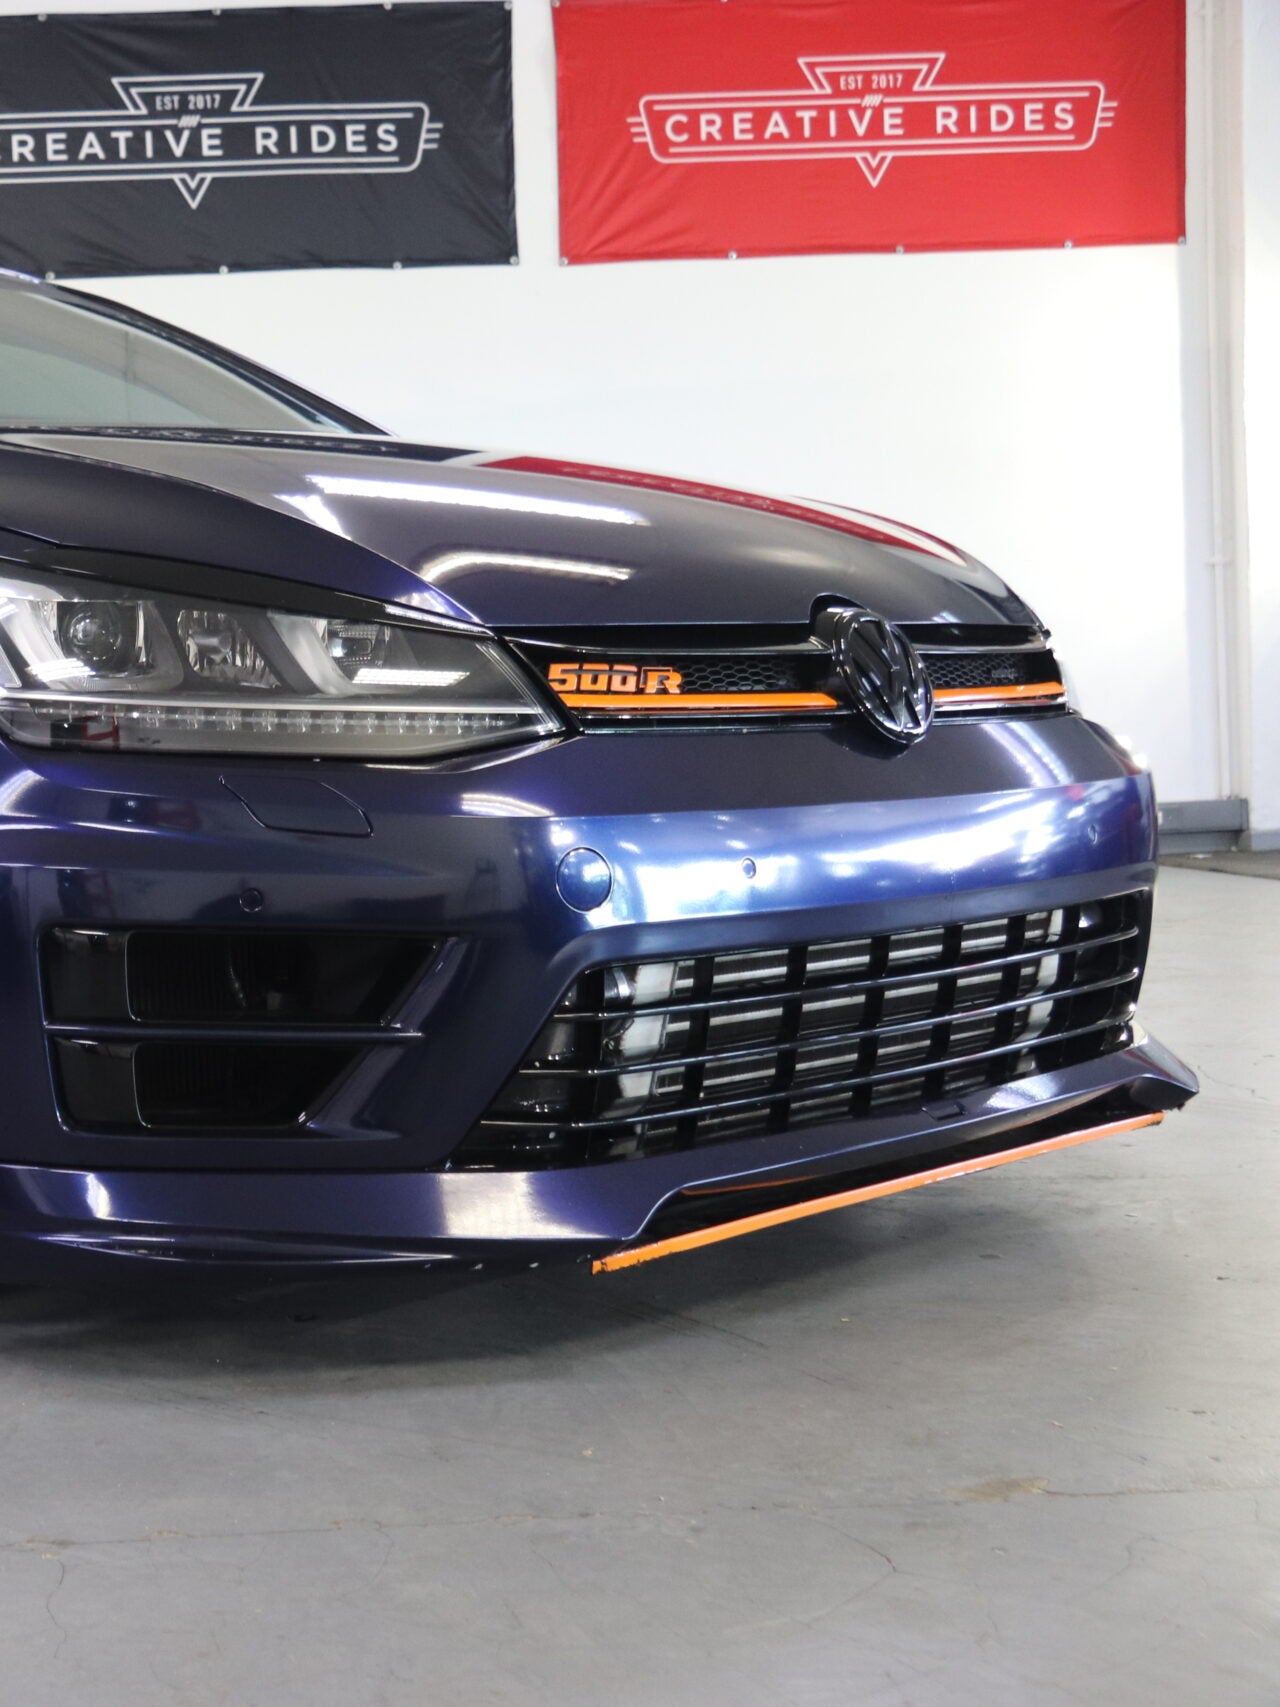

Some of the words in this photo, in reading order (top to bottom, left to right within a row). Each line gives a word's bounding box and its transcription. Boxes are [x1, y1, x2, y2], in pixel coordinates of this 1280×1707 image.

[839, 75, 864, 90] EST
[871, 73, 903, 89] 2017
[155, 95, 180, 111] EST
[187, 93, 221, 110] 2017
[664, 106, 904, 143] CREATIVE
[935, 101, 1076, 135] RIDES
[254, 122, 400, 156] RIDES
[547, 662, 683, 695] 500R
